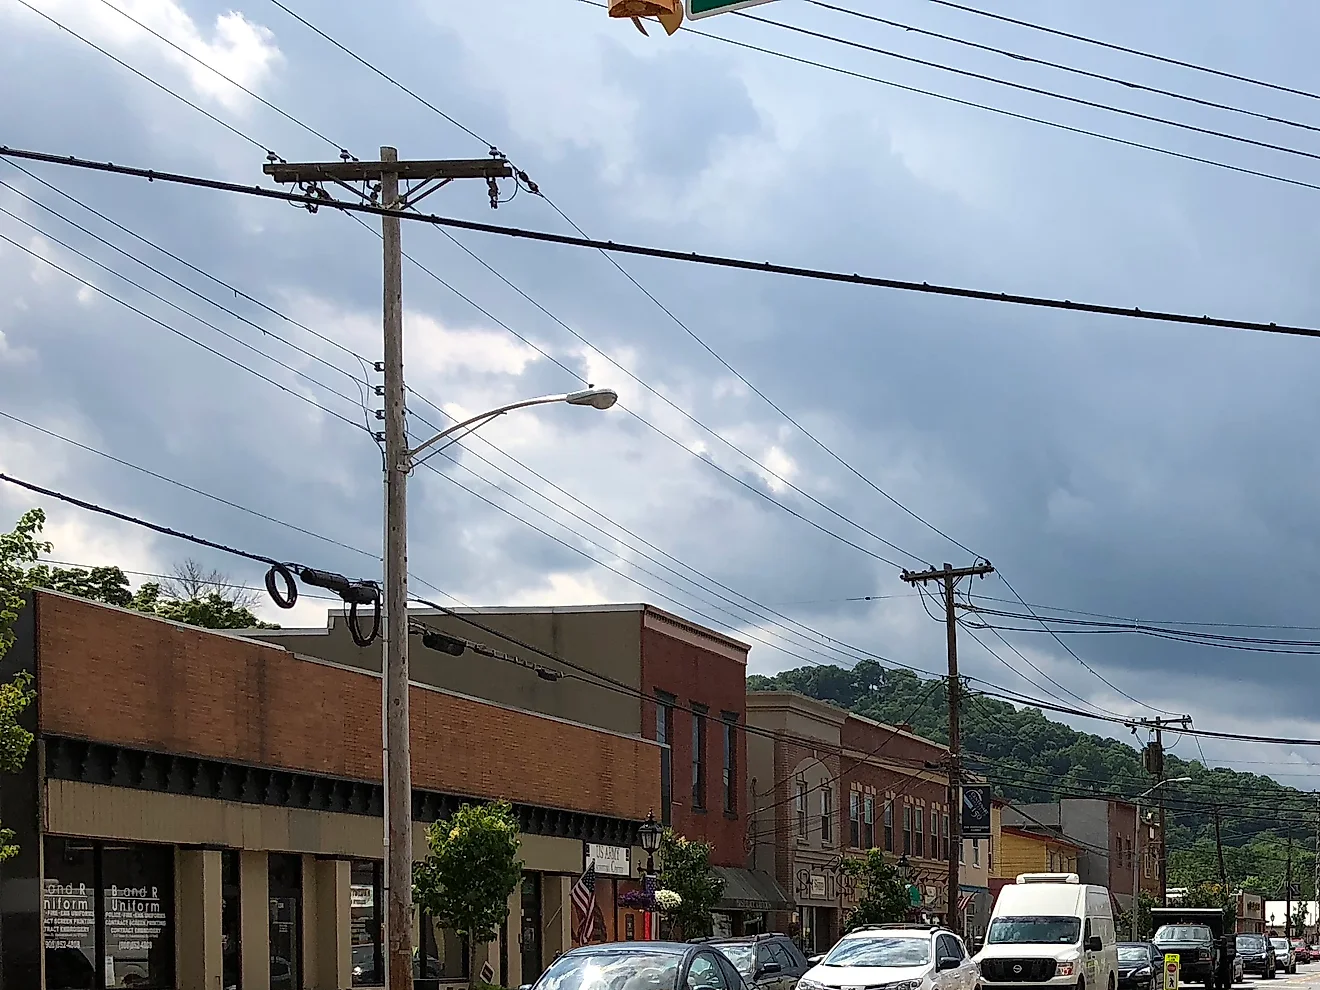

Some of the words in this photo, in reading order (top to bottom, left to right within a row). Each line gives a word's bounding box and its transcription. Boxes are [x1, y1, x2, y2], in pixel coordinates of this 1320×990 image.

[123, 886, 147, 898] and
[44, 897, 88, 910] niform
[111, 899, 160, 912] Uniform
